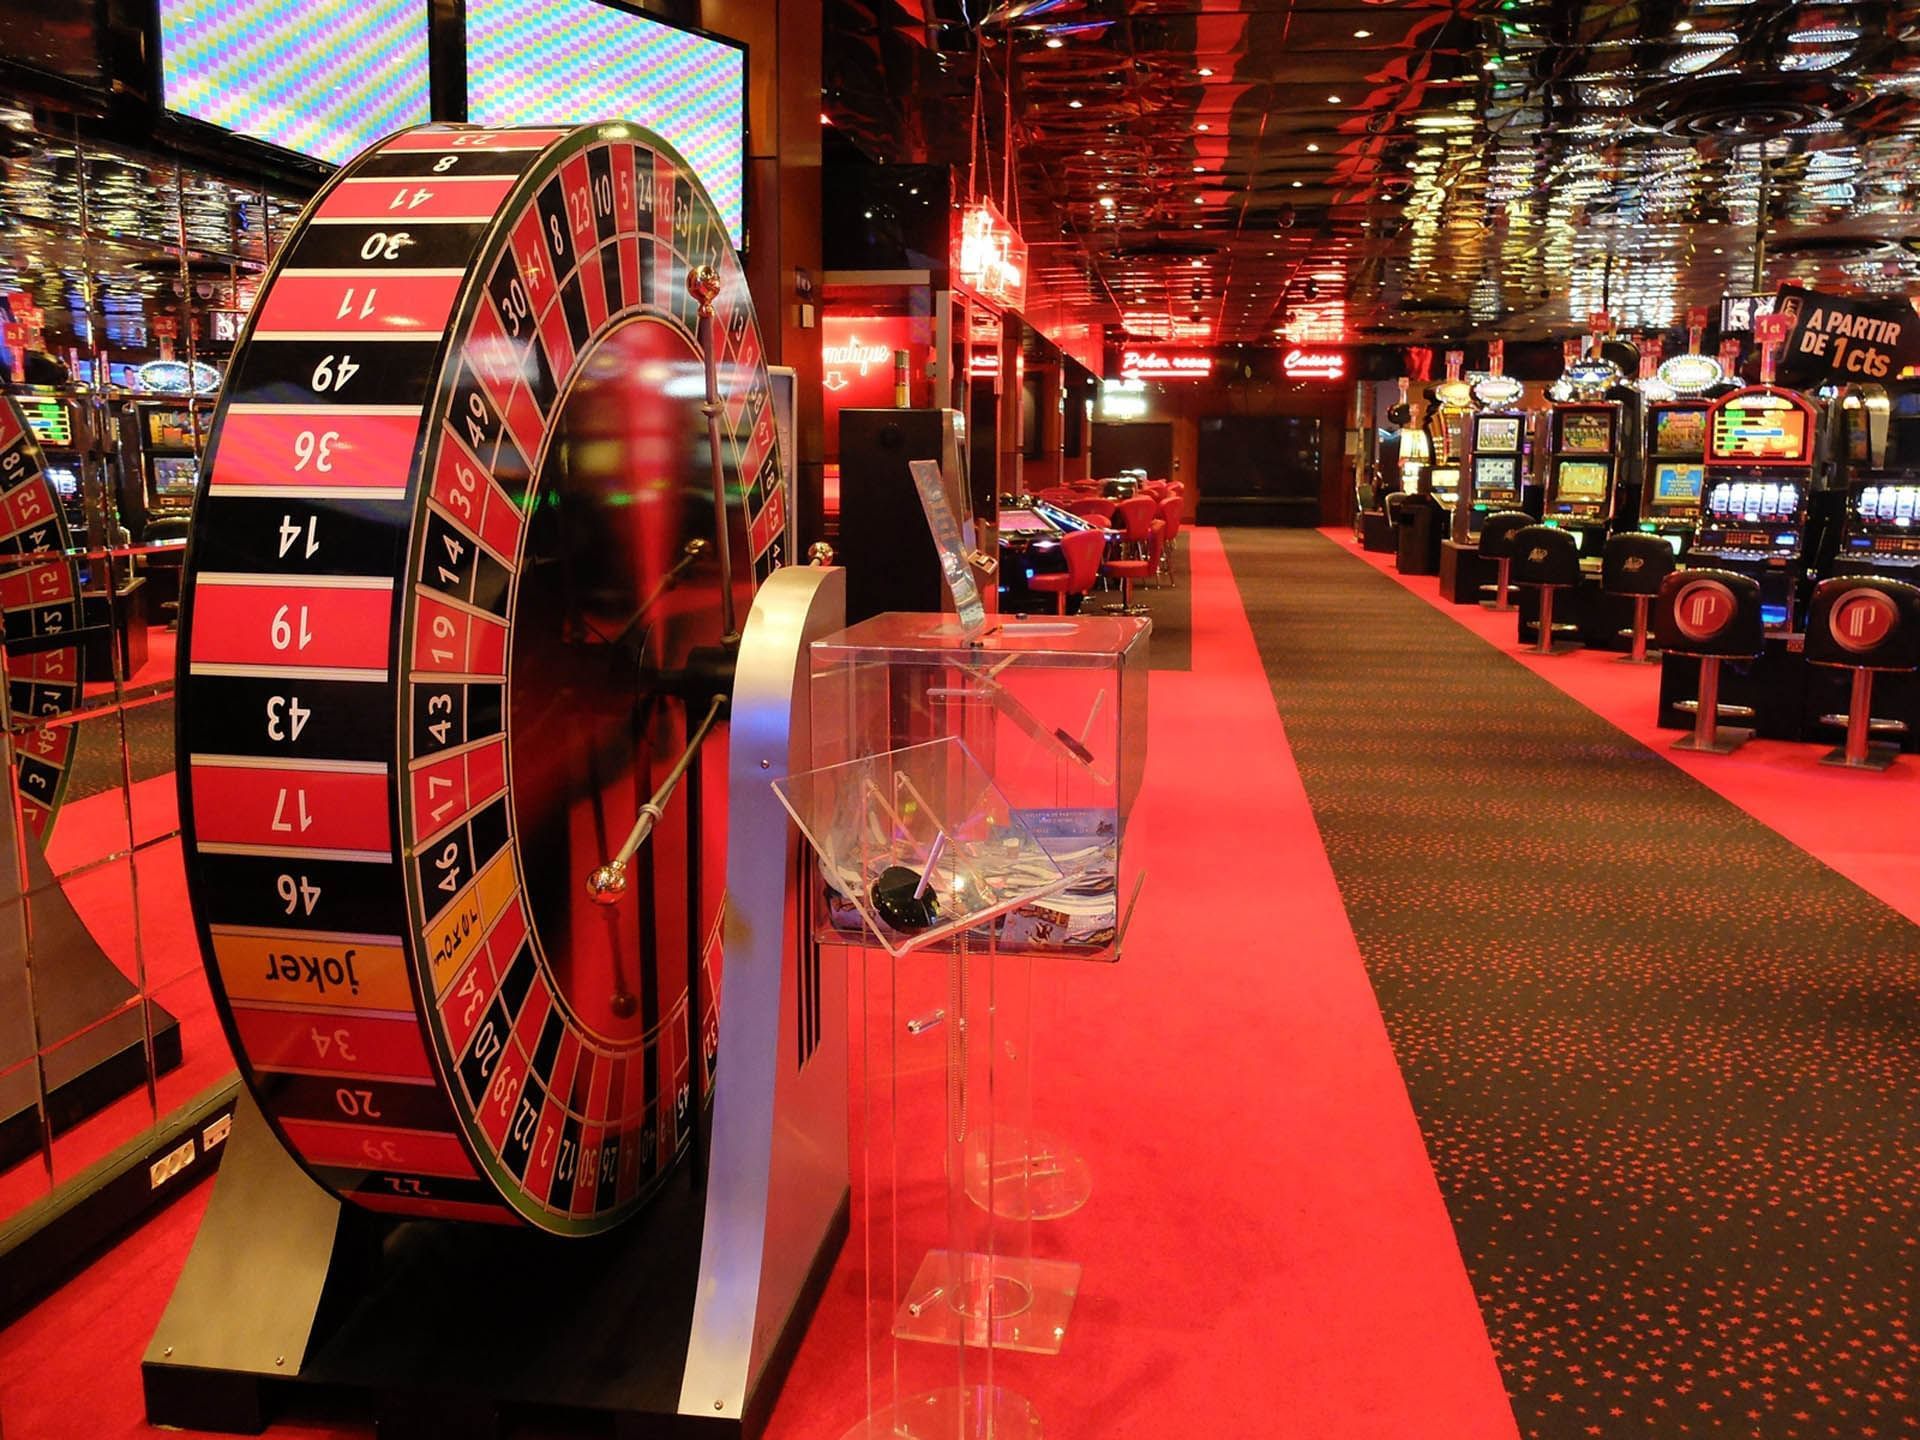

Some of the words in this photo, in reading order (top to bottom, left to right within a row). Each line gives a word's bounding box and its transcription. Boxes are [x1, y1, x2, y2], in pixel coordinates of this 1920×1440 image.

[452, 134, 496, 145] 23
[432, 155, 459, 172] 8
[388, 187, 434, 210] 41
[570, 188, 591, 235] 23
[594, 174, 612, 218] 10
[620, 170, 629, 210] 5
[637, 172, 653, 213] 24
[657, 182, 670, 222] 16
[550, 213, 564, 256] 8
[675, 195, 689, 238] 33
[360, 232, 411, 260] 30
[526, 239, 547, 291] 41
[336, 288, 377, 320] 11
[502, 278, 526, 338] 30
[1760, 318, 1768, 334] 1
[1769, 323, 1781, 334] ct
[1806, 308, 1824, 331] A
[1825, 310, 1902, 346] PARTIR
[311, 354, 361, 392] 49
[1800, 330, 1830, 357] DE
[1831, 336, 1849, 369] 1
[1846, 346, 1892, 378] cts
[467, 393, 491, 450] 49
[759, 421, 770, 446] 47
[294, 430, 340, 472] 36
[448, 462, 476, 520] 36
[764, 459, 776, 491] 18
[768, 499, 780, 532] 25
[278, 515, 321, 560] 14
[438, 533, 465, 585] 14
[270, 604, 313, 652] 19
[432, 615, 457, 665] 19
[266, 695, 312, 743] 43
[428, 693, 453, 745] 43
[271, 788, 313, 833] 17
[427, 775, 454, 823] 17
[435, 841, 460, 893] 46
[277, 873, 322, 917] 46
[265, 949, 361, 996] joker
[456, 967, 484, 1027] 34
[310, 1027, 357, 1063] 34
[475, 1020, 501, 1078] 20
[335, 1088, 382, 1119] 20
[493, 1065, 518, 1118] 39
[514, 1097, 539, 1151] 22
[362, 1139, 405, 1163] 39
[540, 1125, 554, 1168] 2
[558, 1139, 577, 1182] 12
[384, 1176, 431, 1195] 22
[579, 1150, 598, 1188] 50
